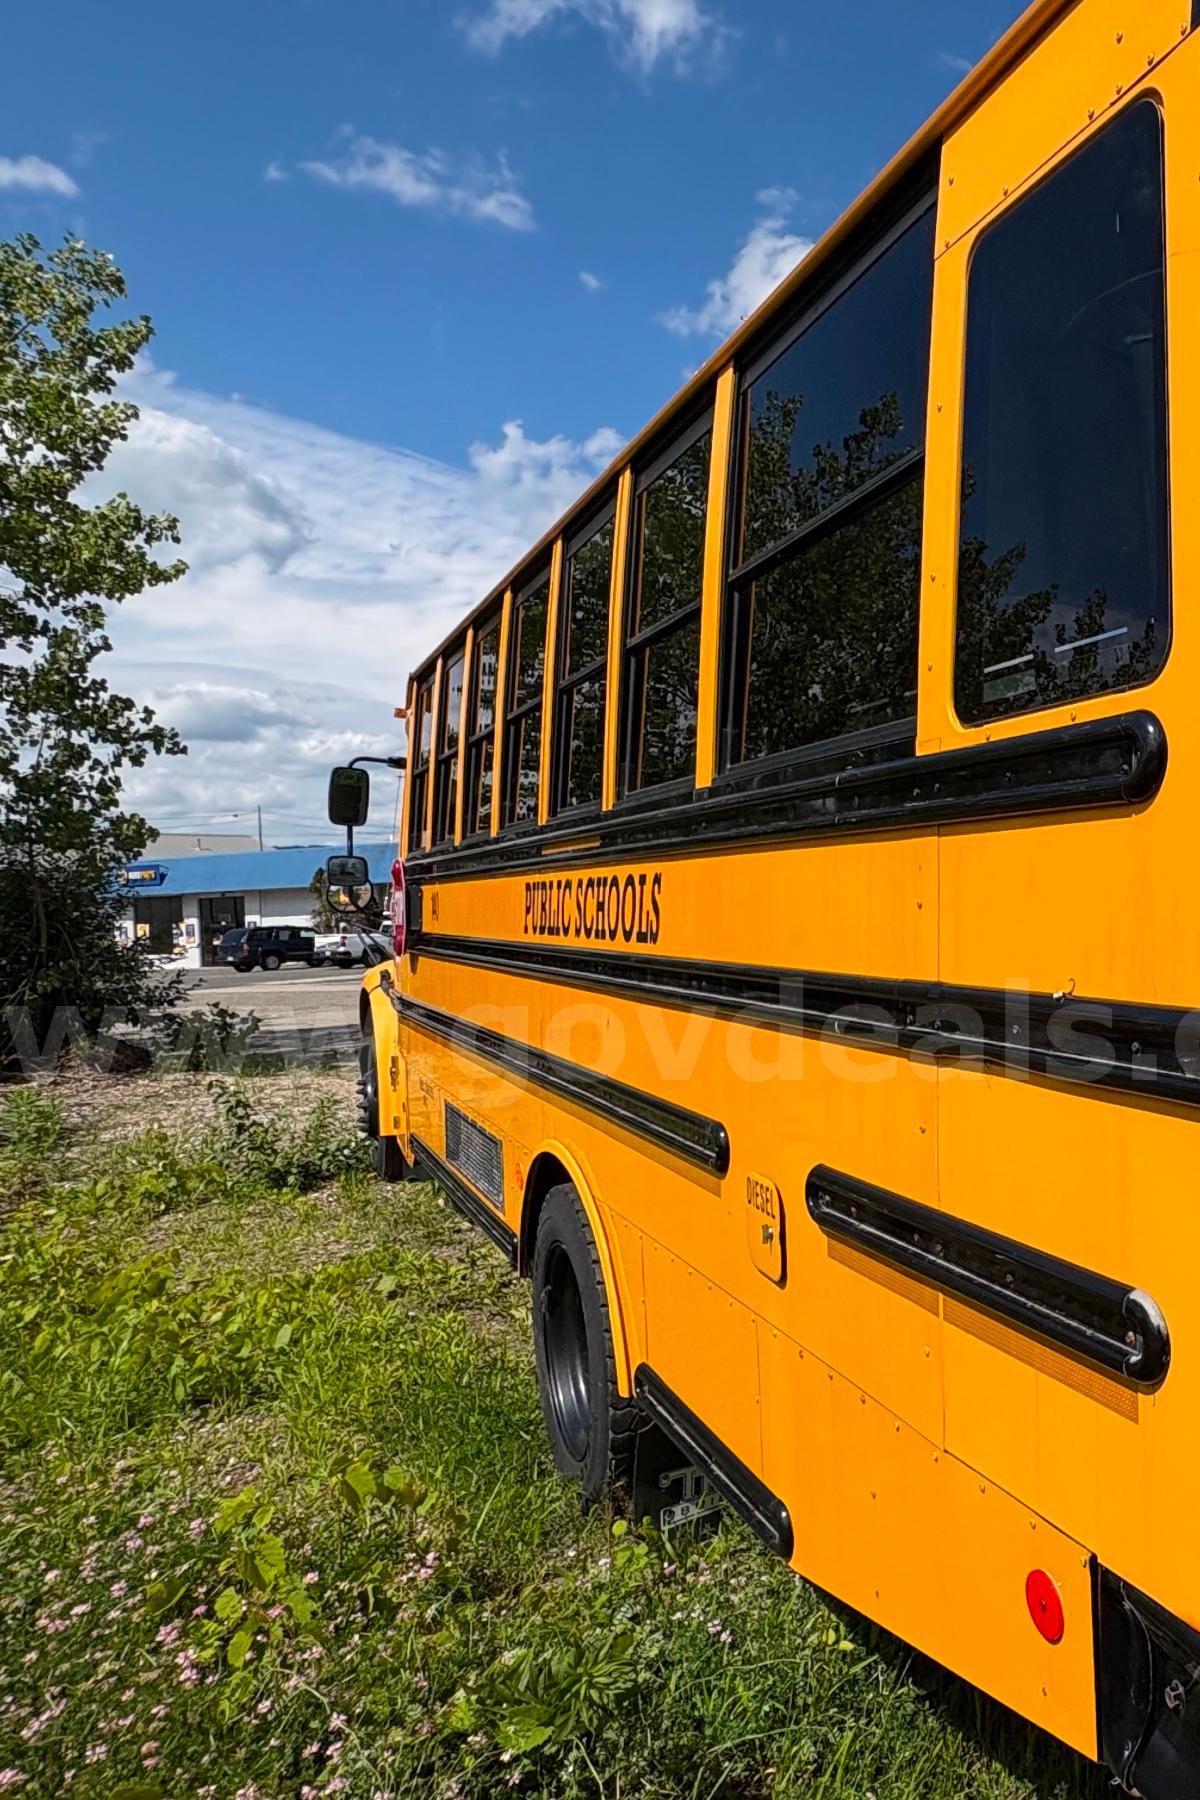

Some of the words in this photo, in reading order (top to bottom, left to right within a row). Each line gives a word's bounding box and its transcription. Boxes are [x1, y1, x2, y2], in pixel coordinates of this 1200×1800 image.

[524, 878, 572, 938] PUBLIC
[575, 872, 662, 945] SCHOOLS
[746, 1176, 776, 1220] DIESEL
